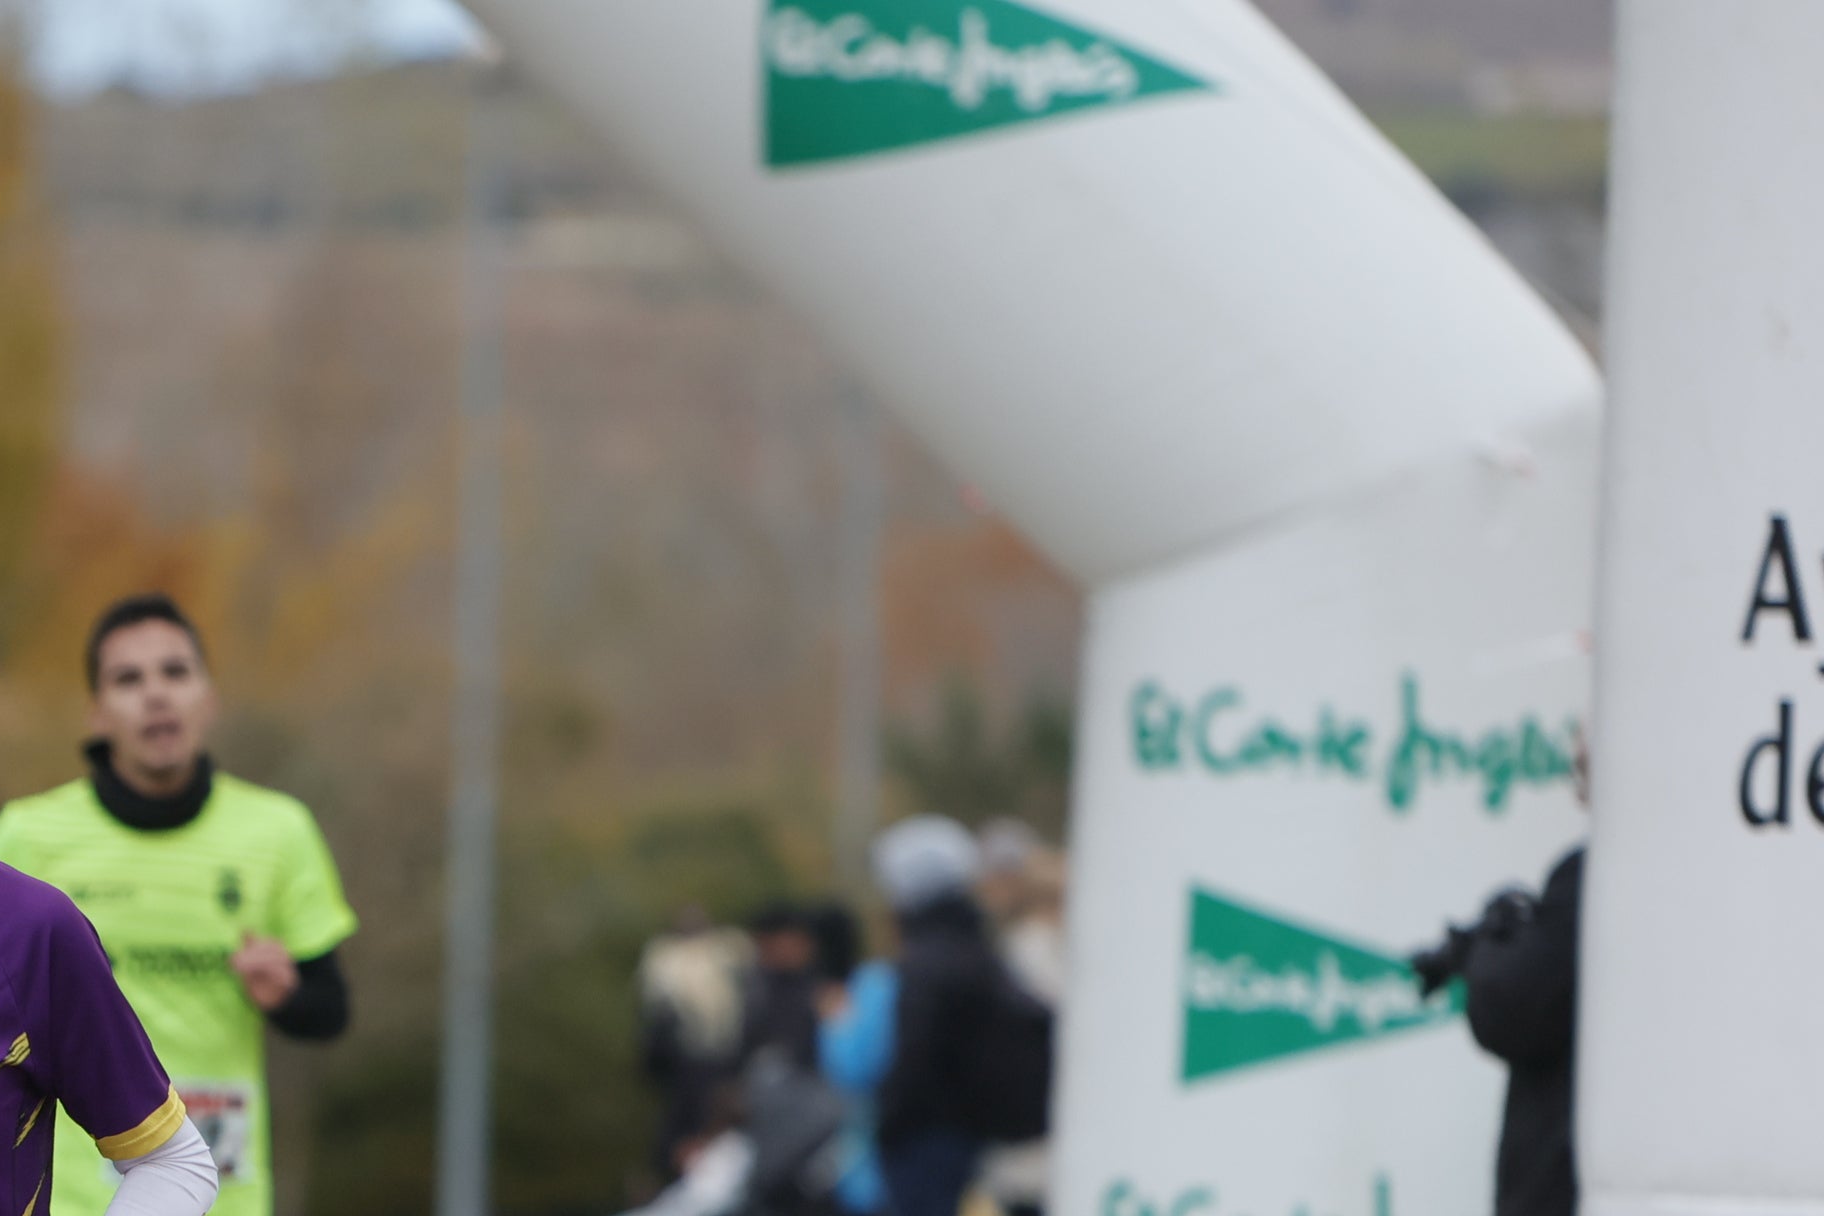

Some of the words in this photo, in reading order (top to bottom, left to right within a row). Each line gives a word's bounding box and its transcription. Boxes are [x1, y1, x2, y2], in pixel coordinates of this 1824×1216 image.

[1739, 509, 1824, 684] A
[1130, 676, 1181, 772] El
[1194, 686, 1370, 780] Corte
